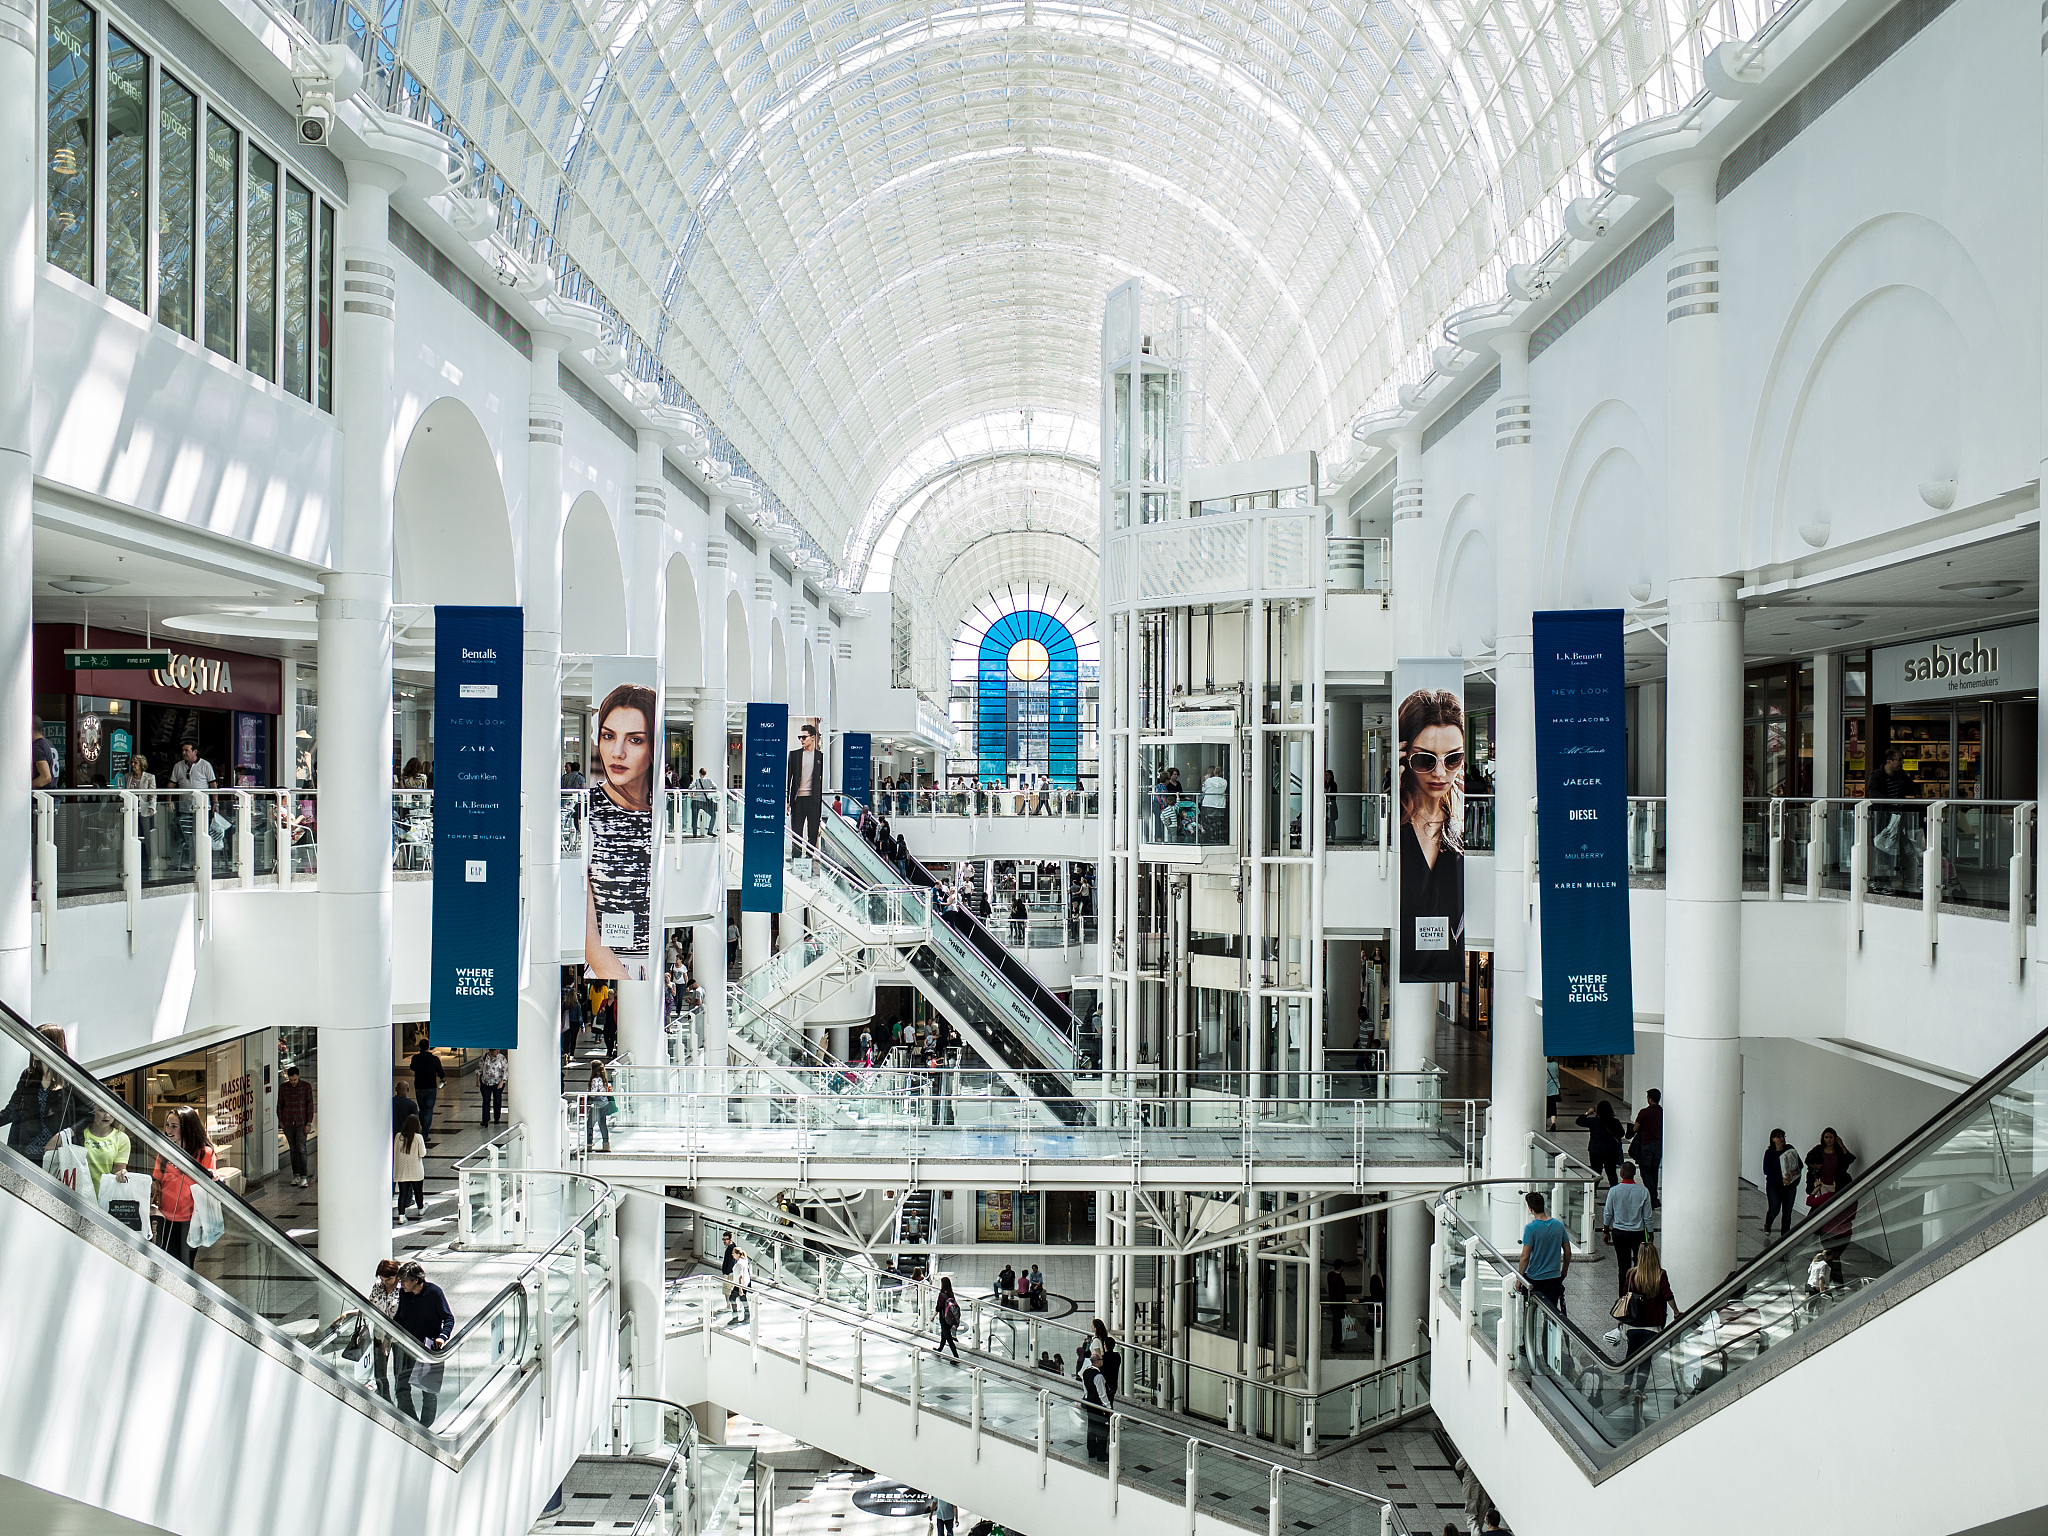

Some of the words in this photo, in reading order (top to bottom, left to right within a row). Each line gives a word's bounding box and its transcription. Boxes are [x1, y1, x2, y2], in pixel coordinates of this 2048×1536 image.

[54, 25, 81, 58] soup
[161, 110, 187, 139] gyoza
[462, 648, 497, 659] Bentalls
[1556, 652, 1602, 660] L.K.Bennett
[155, 652, 233, 695] COSTA
[1948, 681, 1958, 691] the
[1959, 677, 1999, 690] homemakers
[84, 716, 99, 730] COSTA
[82, 742, 101, 760] COFFEE
[458, 772, 479, 780] Calvin
[480, 772, 497, 780] Klein
[1563, 778, 1602, 786] JAEGER
[1569, 809, 1598, 820] DIESEL
[470, 866, 482, 876] GAP
[456, 968, 494, 977] WHERE
[458, 978, 491, 987] STYLE
[948, 937, 966, 958] WHERE
[980, 970, 997, 989] STYLE
[1011, 1002, 1031, 1023] REIGNS
[1568, 974, 1608, 984] WHERE
[455, 986, 494, 996] REIGNS
[1571, 984, 1605, 993] STYLE
[1568, 993, 1608, 1003] REIGNS
[221, 1074, 251, 1098] MASSIVE
[217, 1090, 253, 1117] DISCOUNTS
